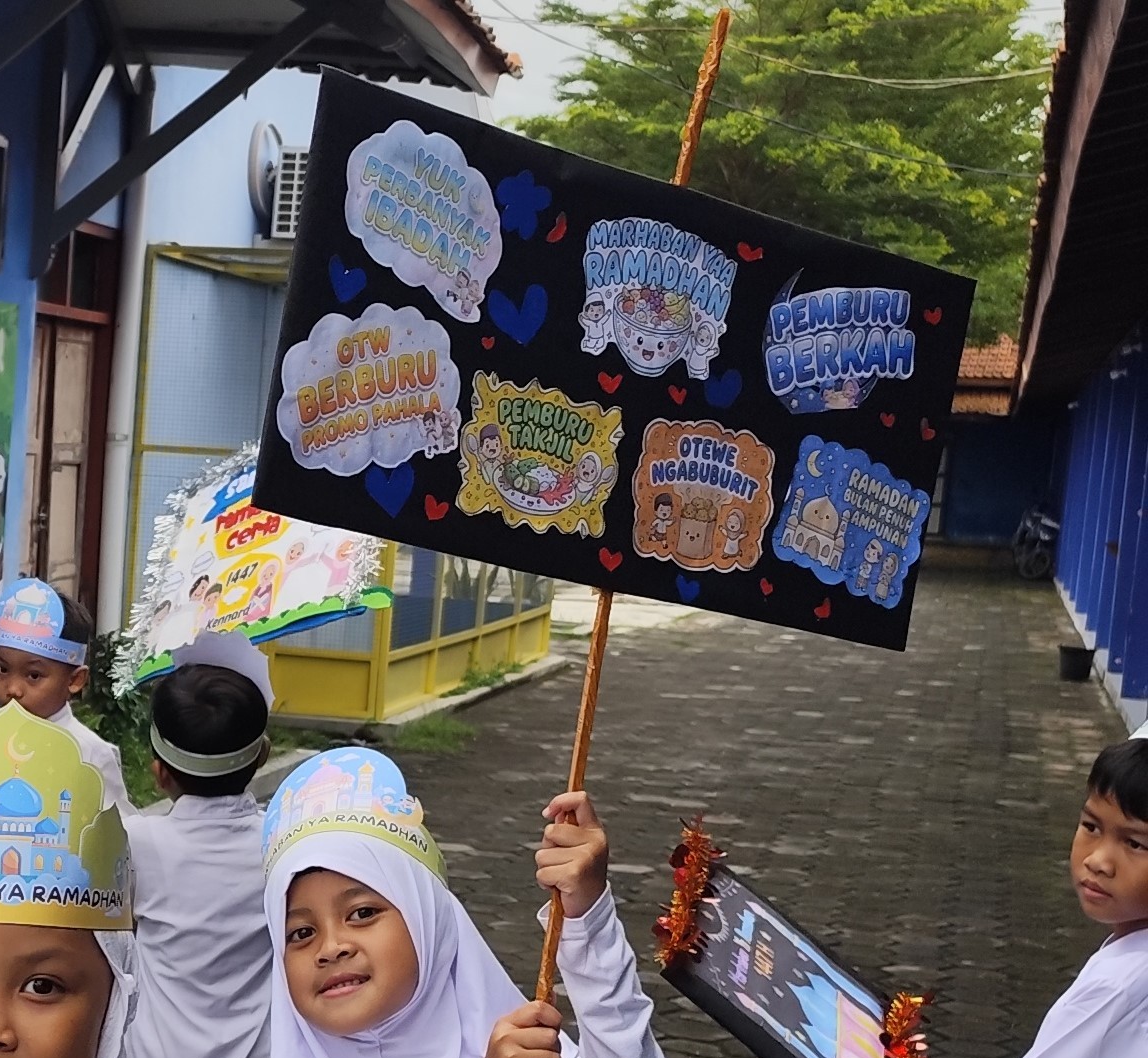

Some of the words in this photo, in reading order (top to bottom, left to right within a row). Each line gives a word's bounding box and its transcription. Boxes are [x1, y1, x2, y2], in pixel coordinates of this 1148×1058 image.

[414, 147, 467, 203] YUK
[362, 155, 491, 256] PERBANYAK
[364, 189, 471, 274] IBADAH
[588, 219, 702, 263] MARHABAN
[702, 242, 737, 287] YAA
[585, 249, 730, 322] RAMADHAN
[771, 289, 909, 341] PEMBURU
[336, 325, 391, 365] OTW
[767, 328, 914, 392] BERKAH
[296, 349, 438, 425] BERBURU
[301, 408, 369, 454] PROMO
[371, 391, 442, 426] PAHALA
[498, 397, 595, 446] PEMBURU
[507, 423, 574, 464] TAKJIL
[679, 436, 738, 468] OTEWE
[651, 459, 759, 501] NGABUBURIT
[848, 468, 920, 519] RAMADAN
[843, 488, 878, 515] BULAN
[878, 505, 915, 534] PENUH
[851, 510, 909, 550] AMPUNAN
[225, 562, 259, 587] 1447
[308, 816, 330, 827] YA
[335, 814, 428, 854] RAMADHAN
[32, 885, 125, 908] RAMADHAN
